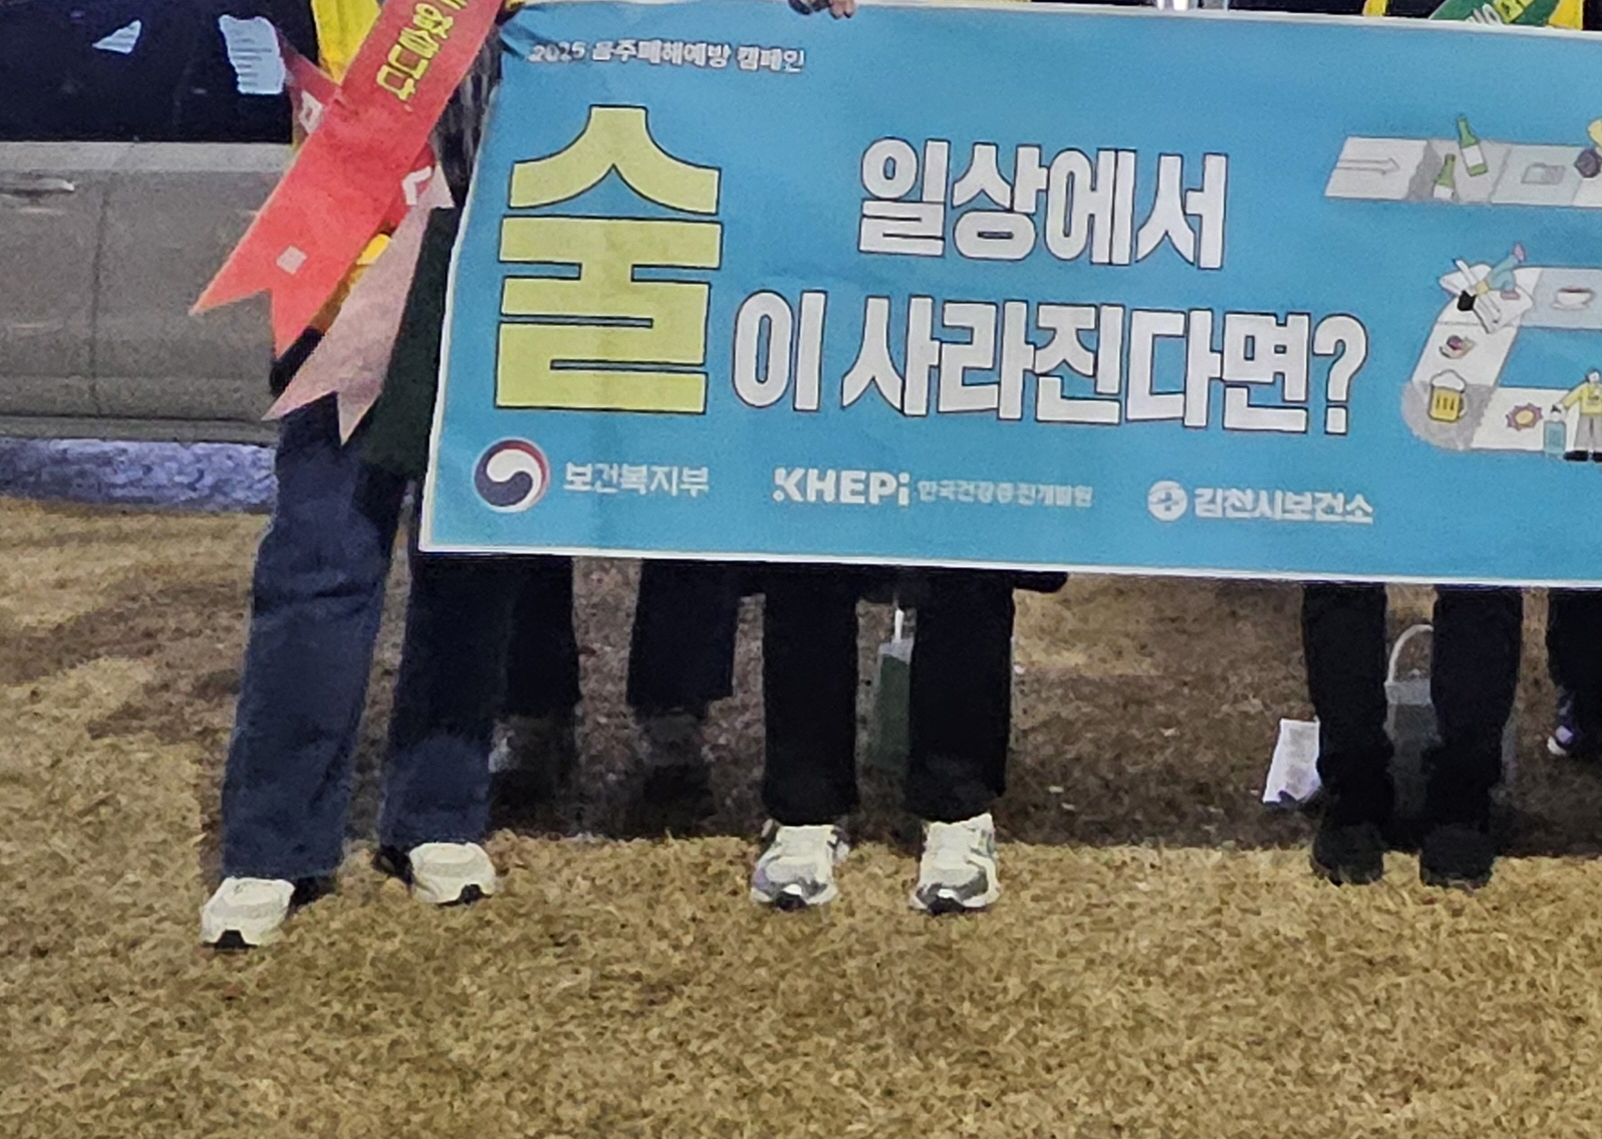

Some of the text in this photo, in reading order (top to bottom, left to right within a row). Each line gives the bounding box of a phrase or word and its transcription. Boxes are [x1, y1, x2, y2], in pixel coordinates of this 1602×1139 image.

[528, 39, 805, 73] 2025 음주폐해예방 캠페인
[857, 136, 1229, 269] 일상에서
[841, 292, 1368, 434] 사라진다면?
[563, 461, 710, 497] 보건복지부
[1194, 488, 1374, 524] 김천시보건소
